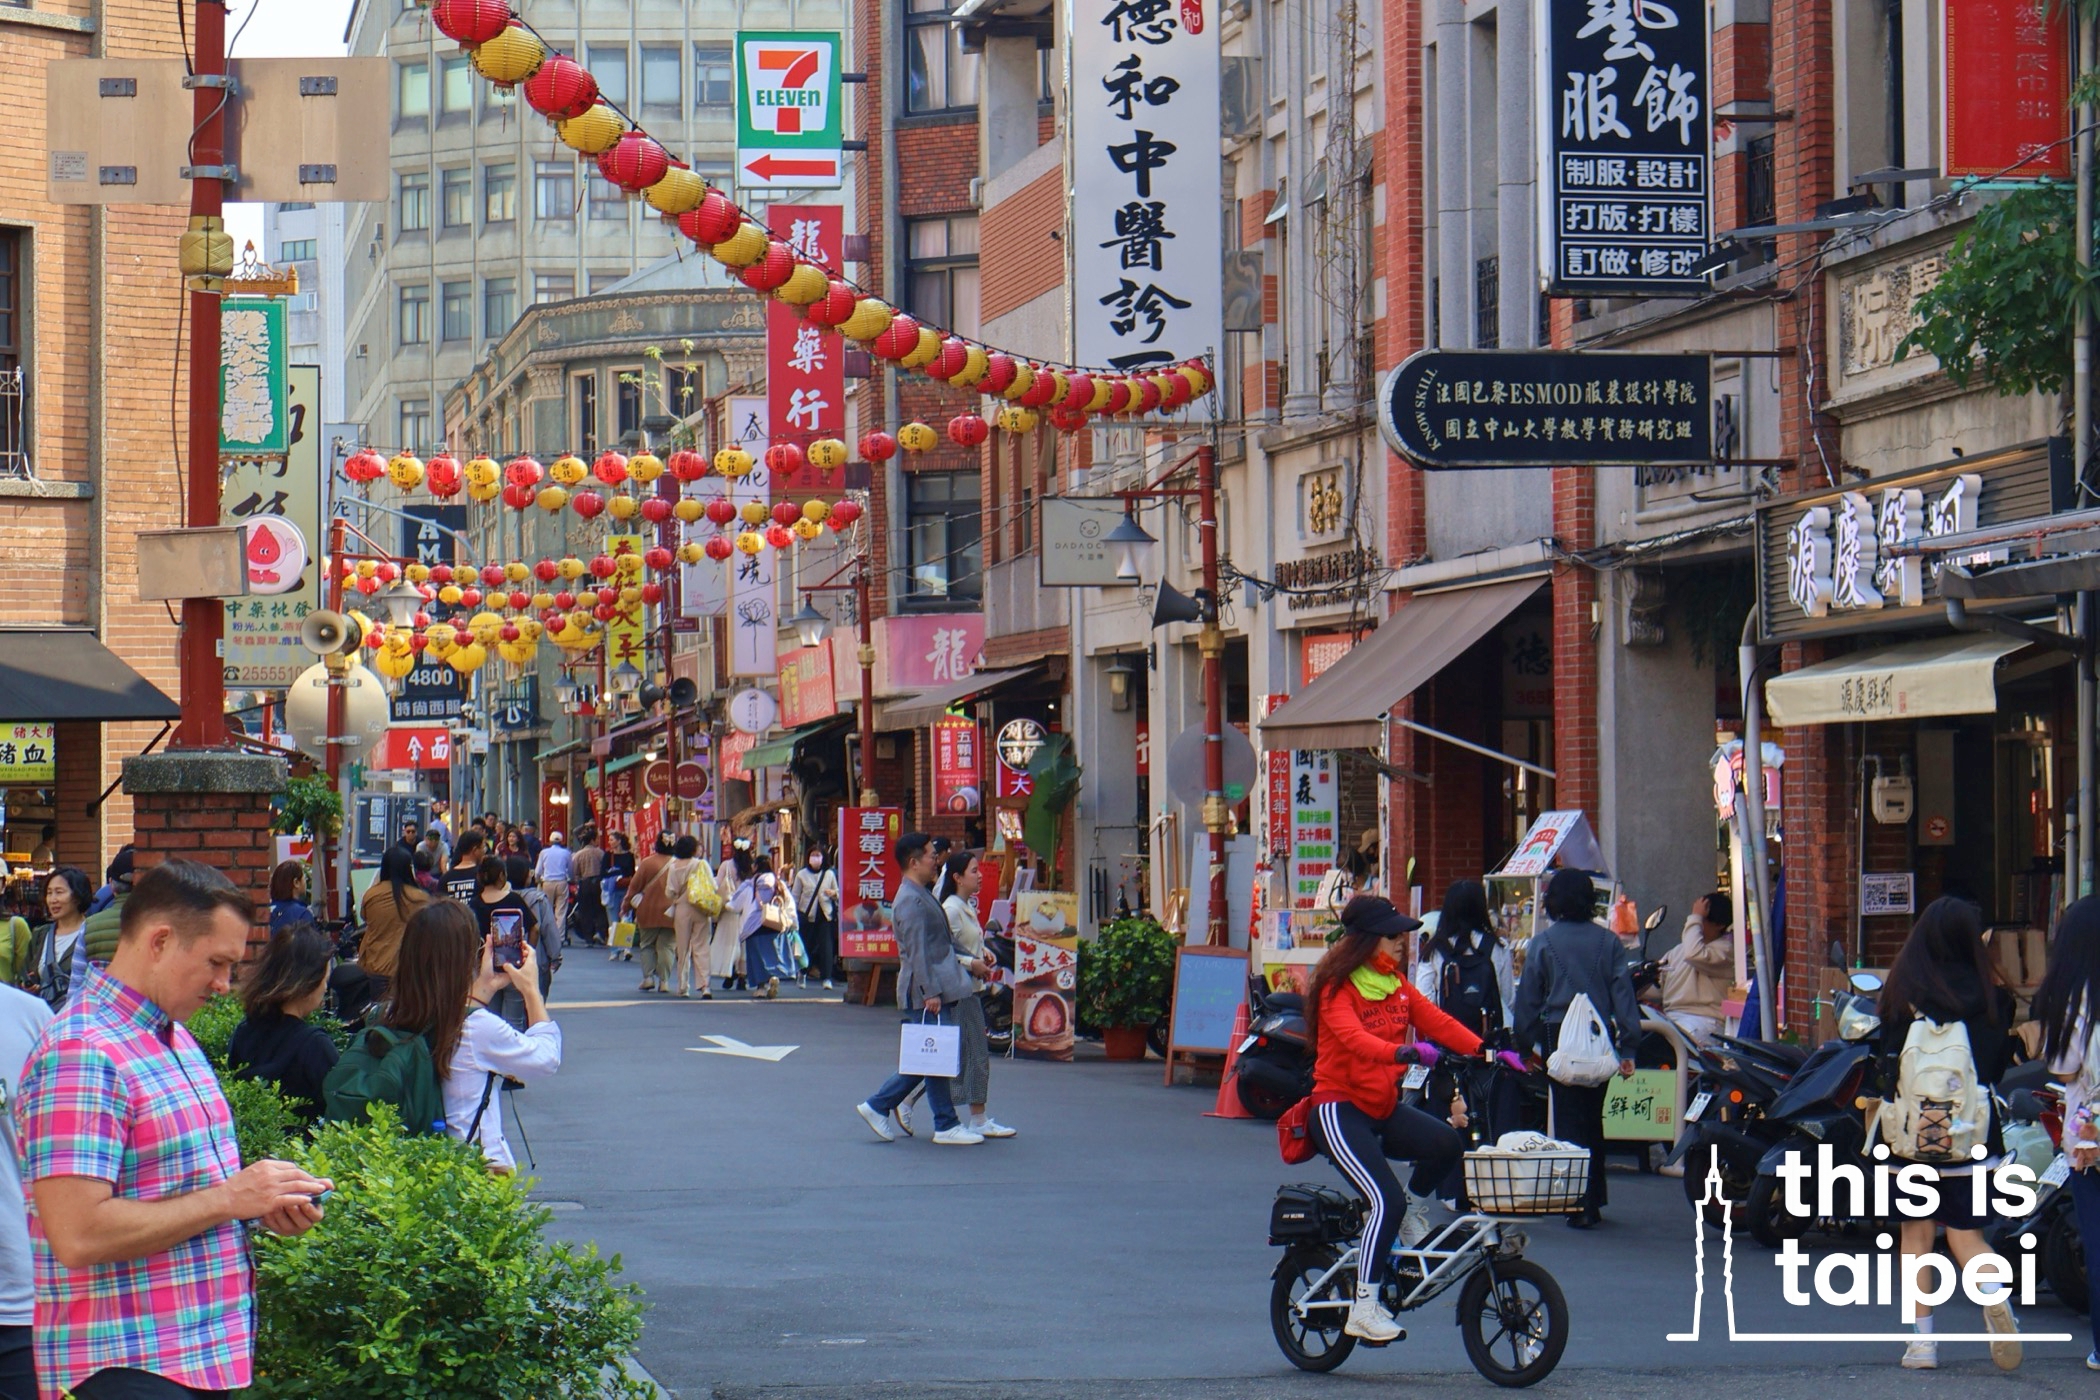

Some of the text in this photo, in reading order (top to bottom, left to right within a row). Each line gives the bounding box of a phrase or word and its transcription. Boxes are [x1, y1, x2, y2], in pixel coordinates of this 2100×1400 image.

[1563, 64, 1698, 146] 服飾
[1099, 0, 1192, 367] 德和中醫診
[787, 219, 828, 431] 龍藥行
[225, 600, 313, 618] 中藥批發
[242, 666, 308, 681] 2555510
[408, 669, 453, 686] 4800
[395, 699, 461, 717] 時尚西服
[0, 743, 55, 765] 豬血
[1271, 749, 1289, 851] 22草莓大福
[858, 811, 886, 900] 草莓大福
